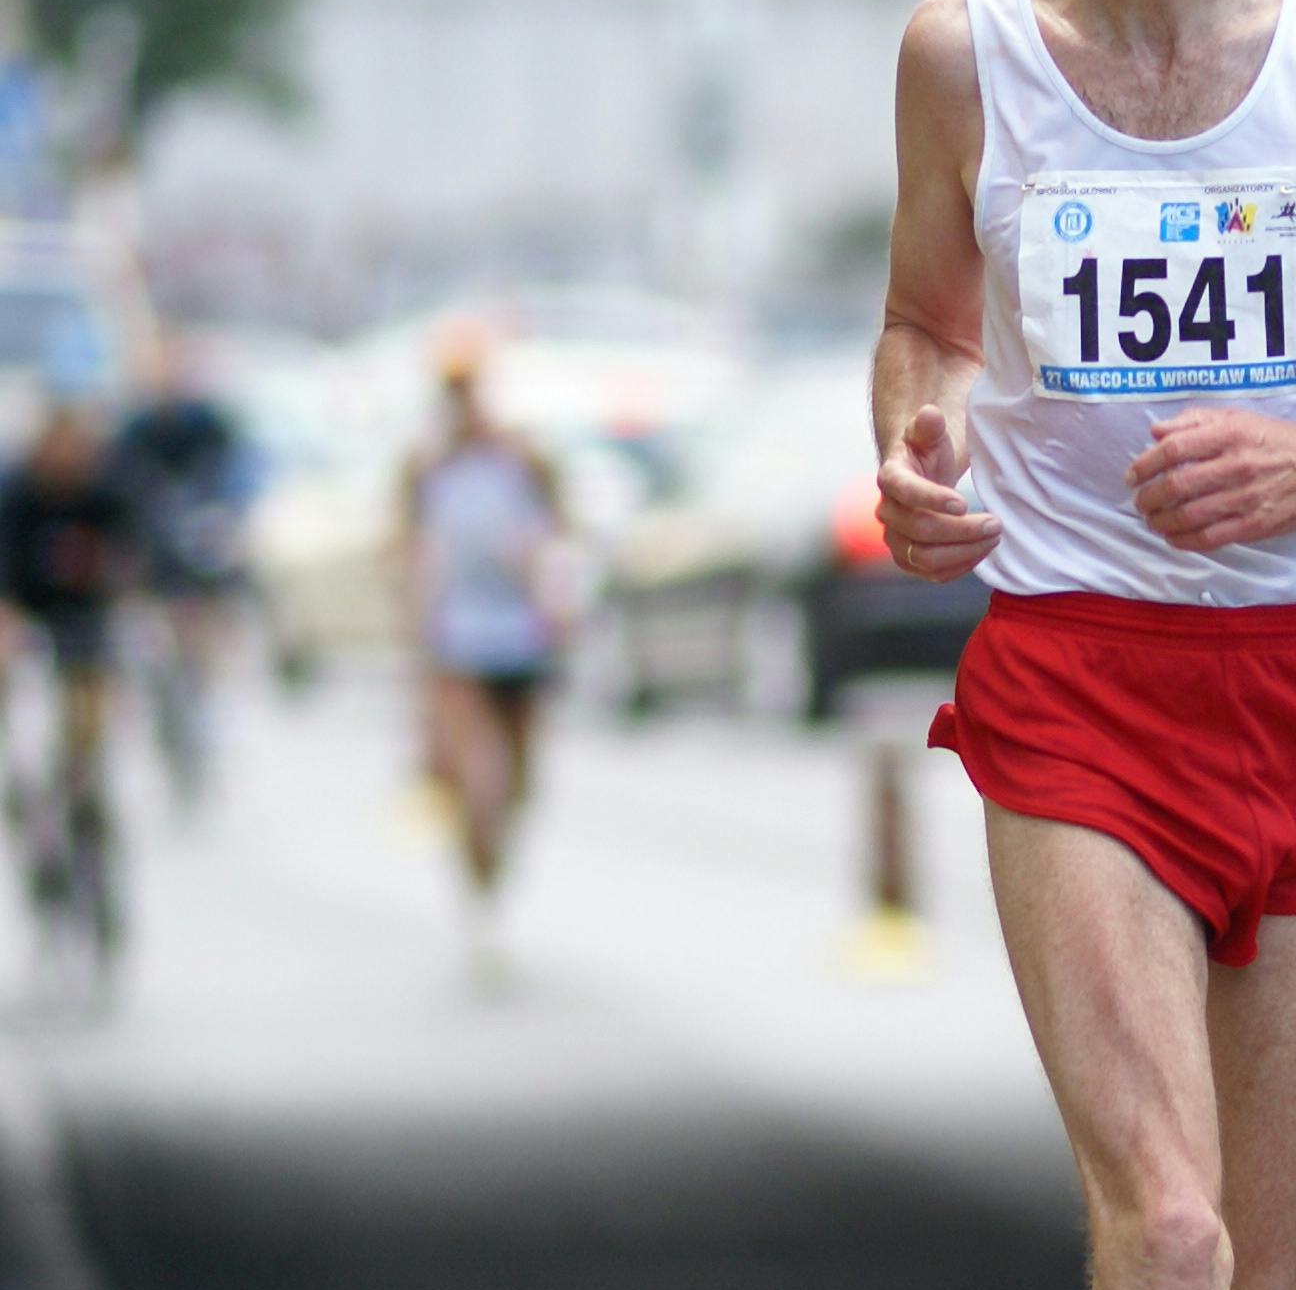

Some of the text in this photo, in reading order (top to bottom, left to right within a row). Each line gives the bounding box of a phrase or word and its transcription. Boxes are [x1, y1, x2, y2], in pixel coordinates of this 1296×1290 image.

[1062, 254, 1286, 363] 1541
[1069, 370, 1157, 388] HASCO-LEK
[1160, 367, 1246, 388] WROCŁAW
